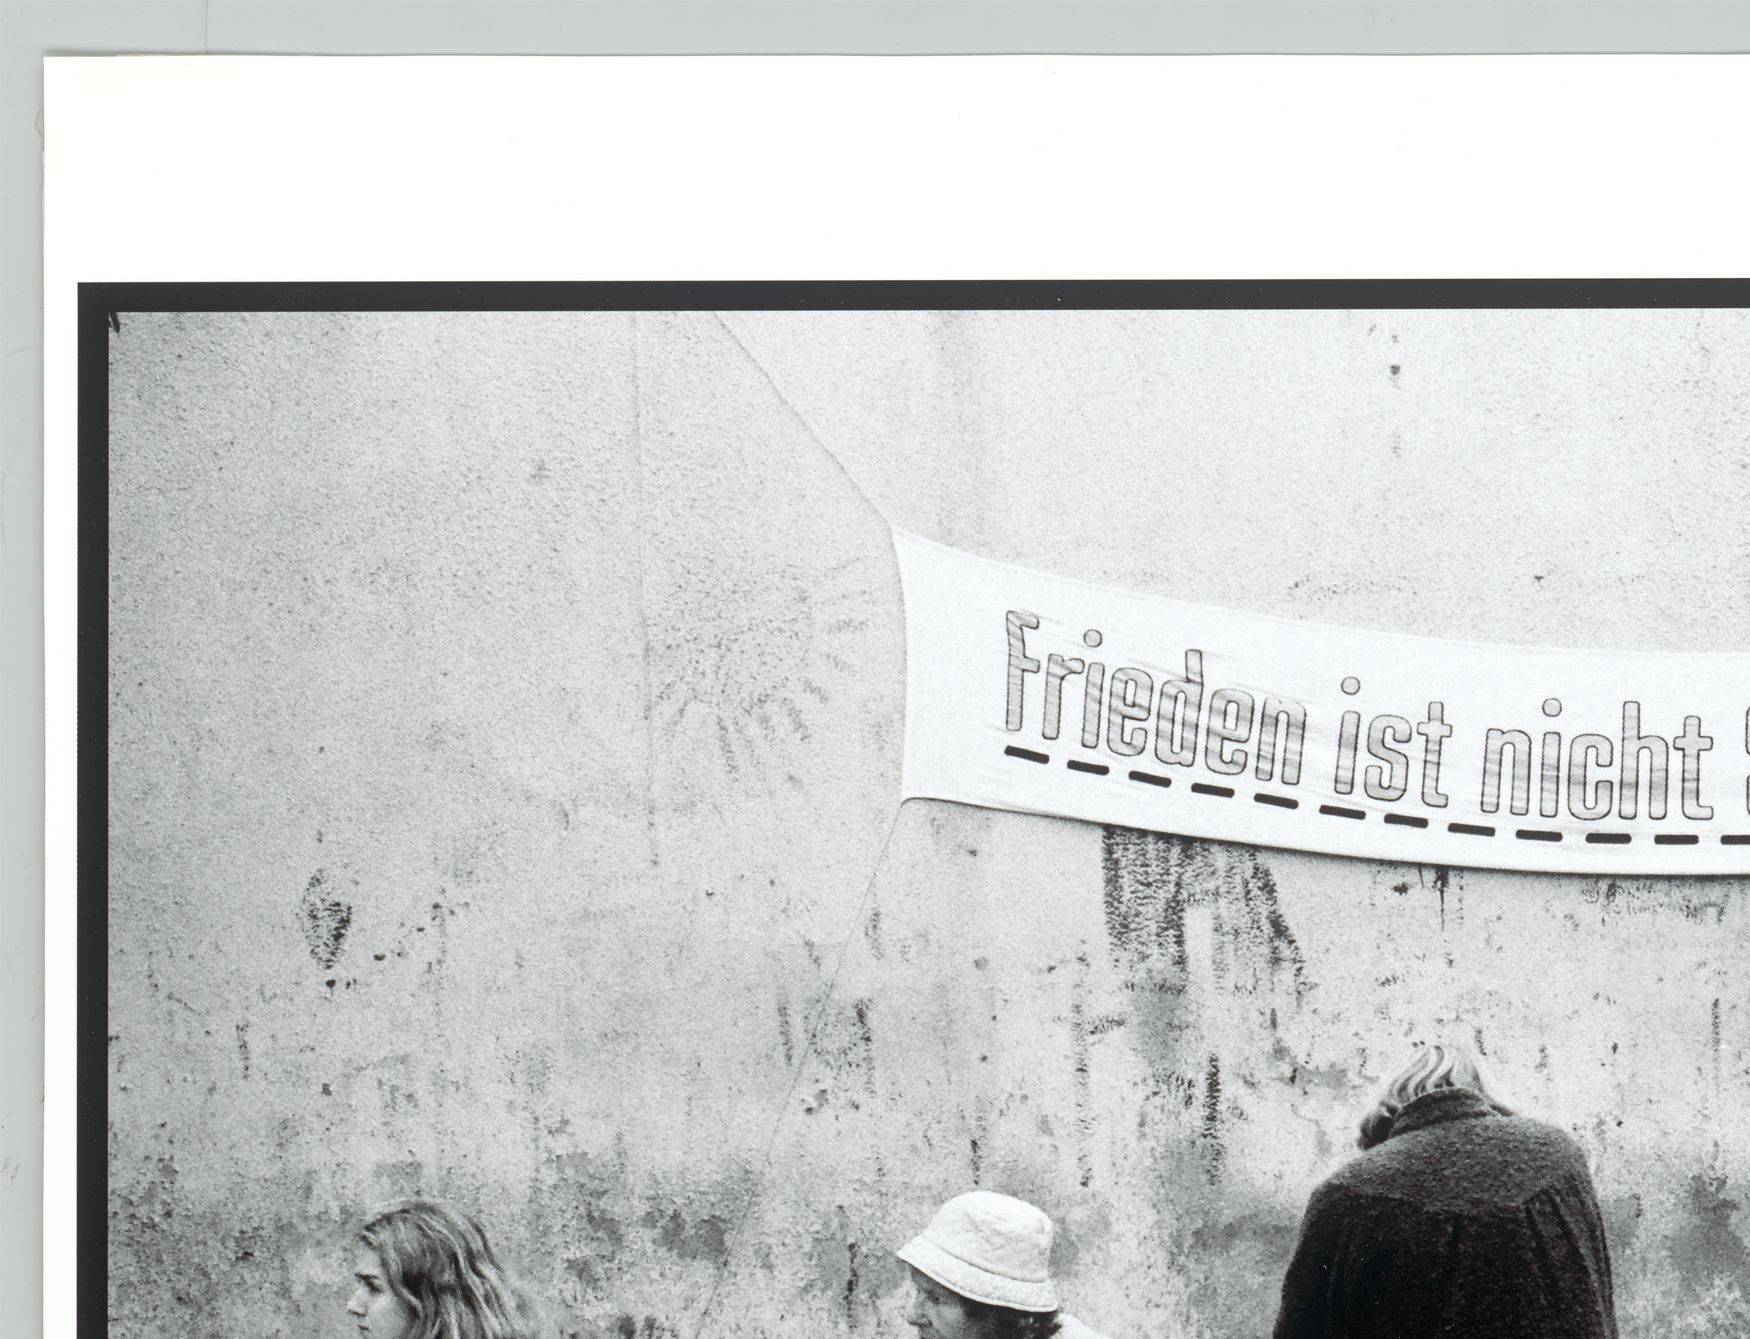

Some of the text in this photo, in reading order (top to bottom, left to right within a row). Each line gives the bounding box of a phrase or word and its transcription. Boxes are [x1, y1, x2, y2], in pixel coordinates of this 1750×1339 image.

[1005, 609, 1307, 785] Frieden
[1334, 676, 1453, 807] ist
[1480, 697, 1715, 822] nicht
